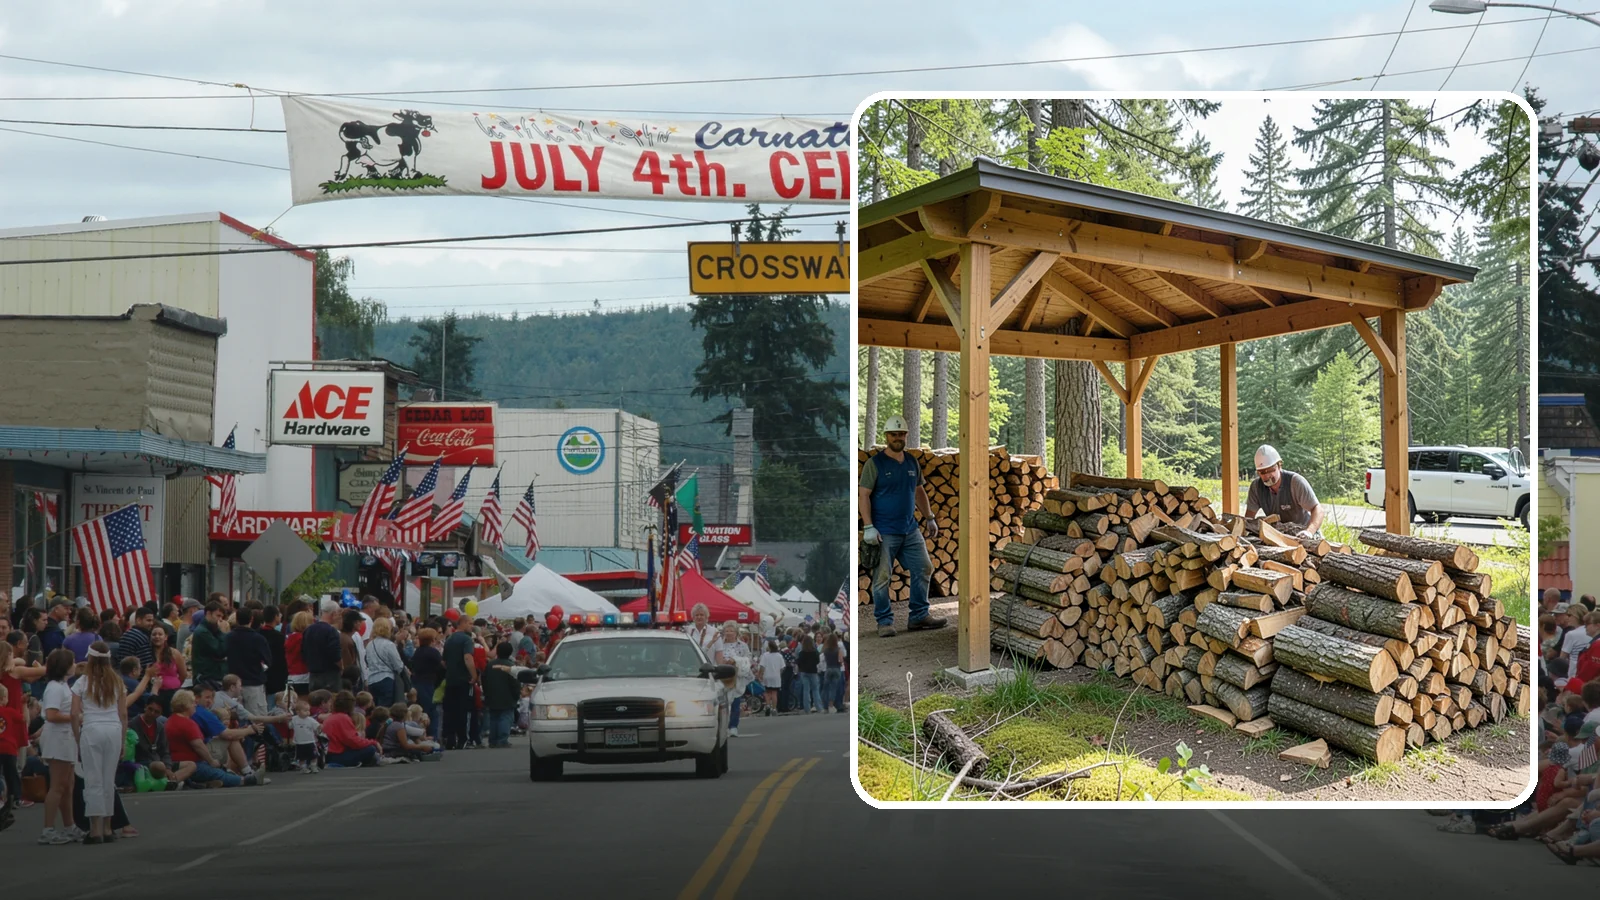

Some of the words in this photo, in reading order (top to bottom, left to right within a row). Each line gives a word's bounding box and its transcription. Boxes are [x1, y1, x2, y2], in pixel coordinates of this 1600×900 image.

[695, 122, 849, 150] Carnat
[481, 141, 605, 192] JULY
[632, 150, 746, 198] 4th.
[697, 254, 850, 280] CROSSWA
[283, 380, 373, 420] ACE
[405, 409, 452, 422] CEDAR
[283, 421, 371, 436] Hardware
[416, 428, 477, 447] Coca-Cola
[353, 467, 386, 480] Simpl
[95, 484, 125, 495] Vincent
[126, 485, 136, 495] de
[137, 485, 155, 495] Paul
[688, 526, 741, 535] CRNATION
[699, 535, 730, 543] GLASS
